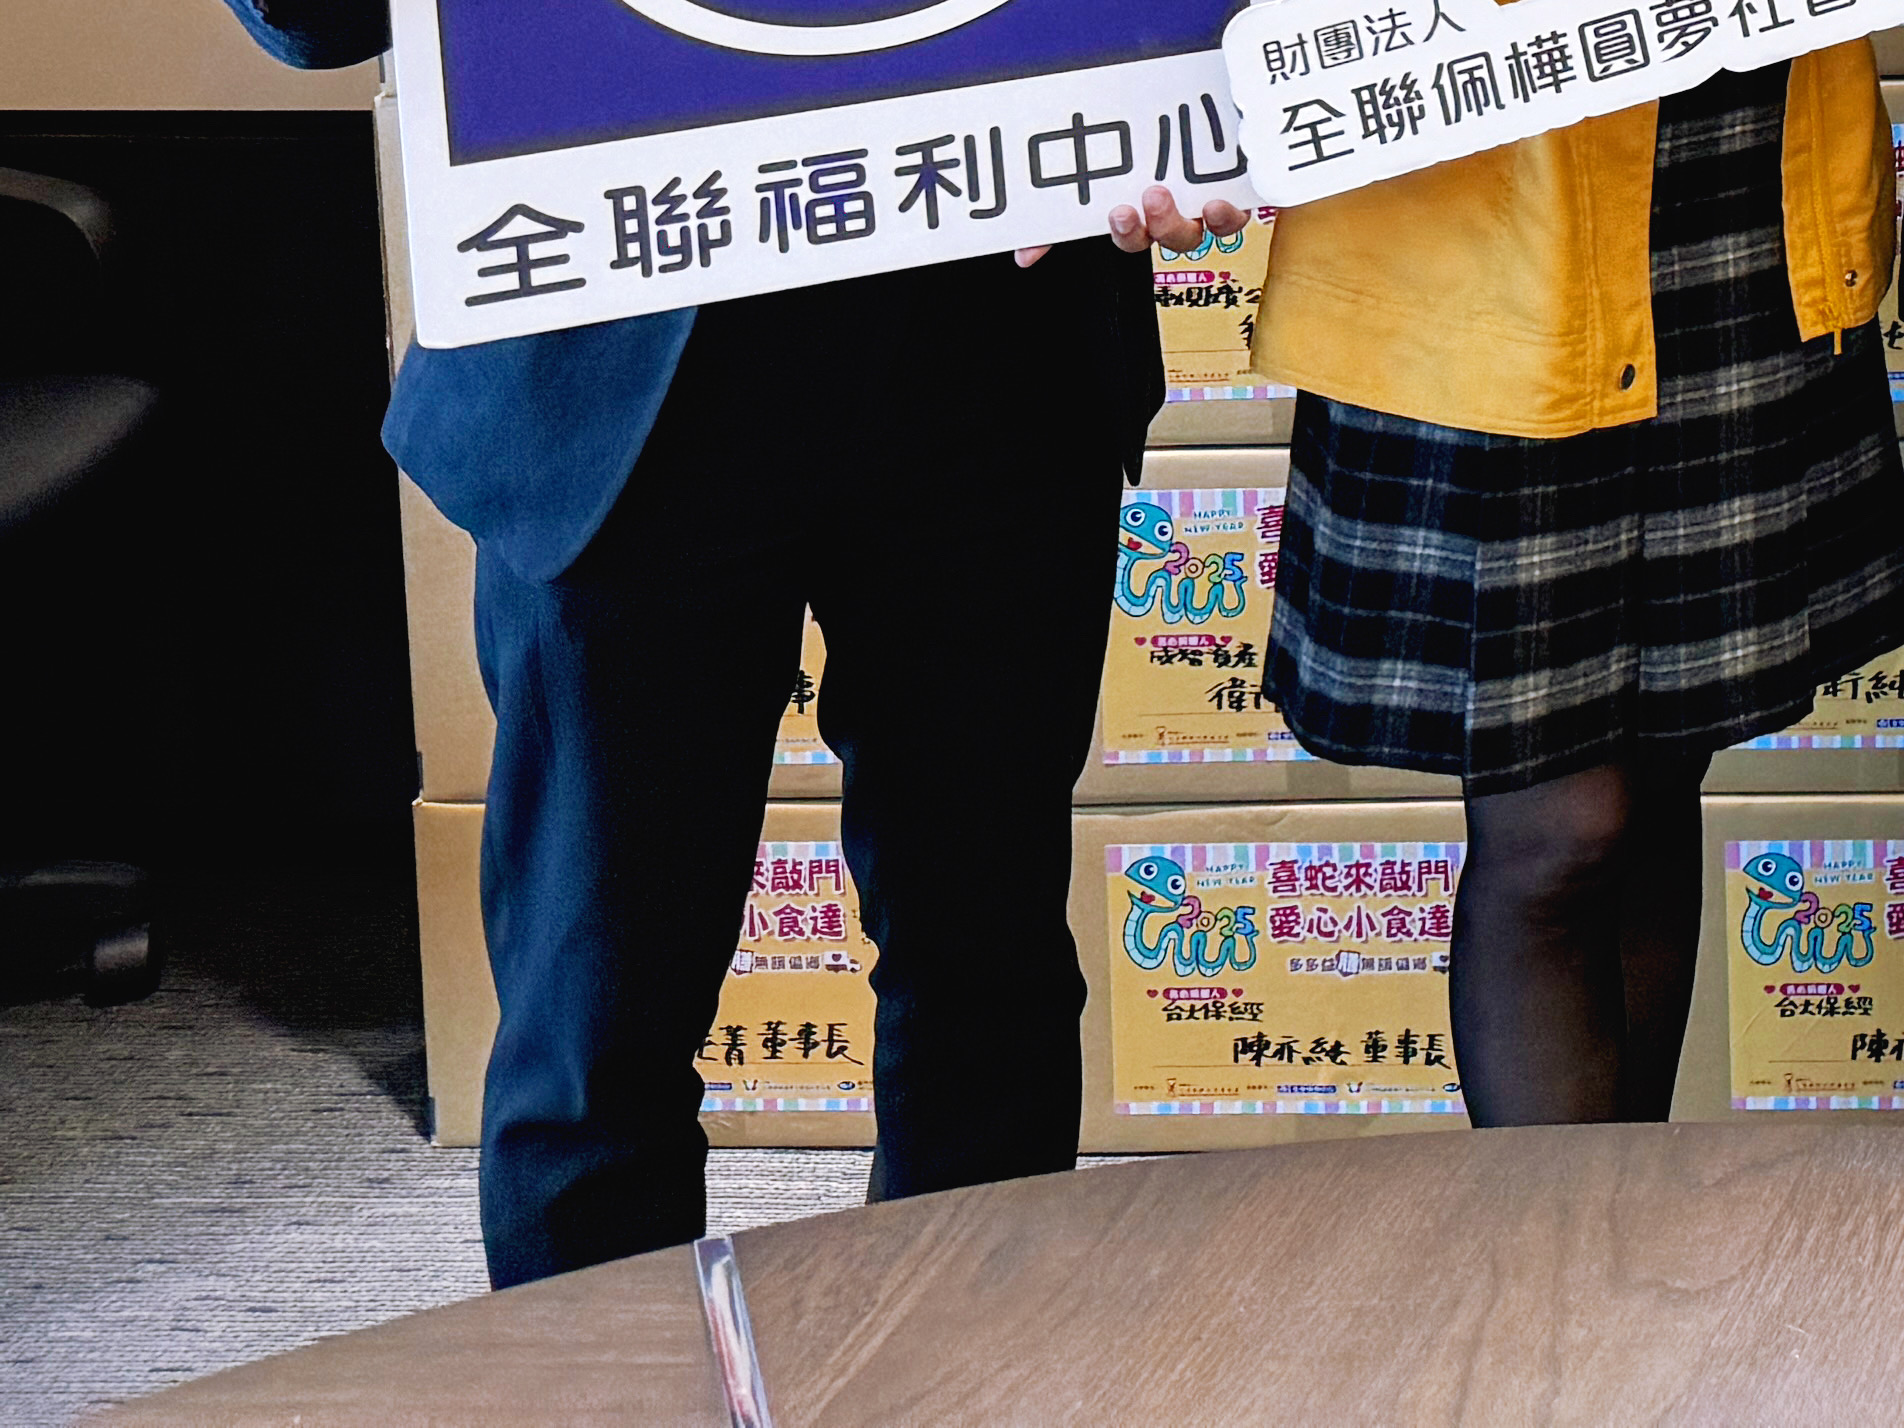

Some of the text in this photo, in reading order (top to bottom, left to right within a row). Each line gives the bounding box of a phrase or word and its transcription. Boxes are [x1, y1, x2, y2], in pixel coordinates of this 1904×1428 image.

[456, 90, 1246, 309] 全聯福利中心
[1165, 540, 1246, 579] 2025
[1268, 859, 1451, 894] 喜蛇來敲門
[1268, 903, 1452, 940] 愛心小食達
[1795, 891, 1875, 929] 2025
